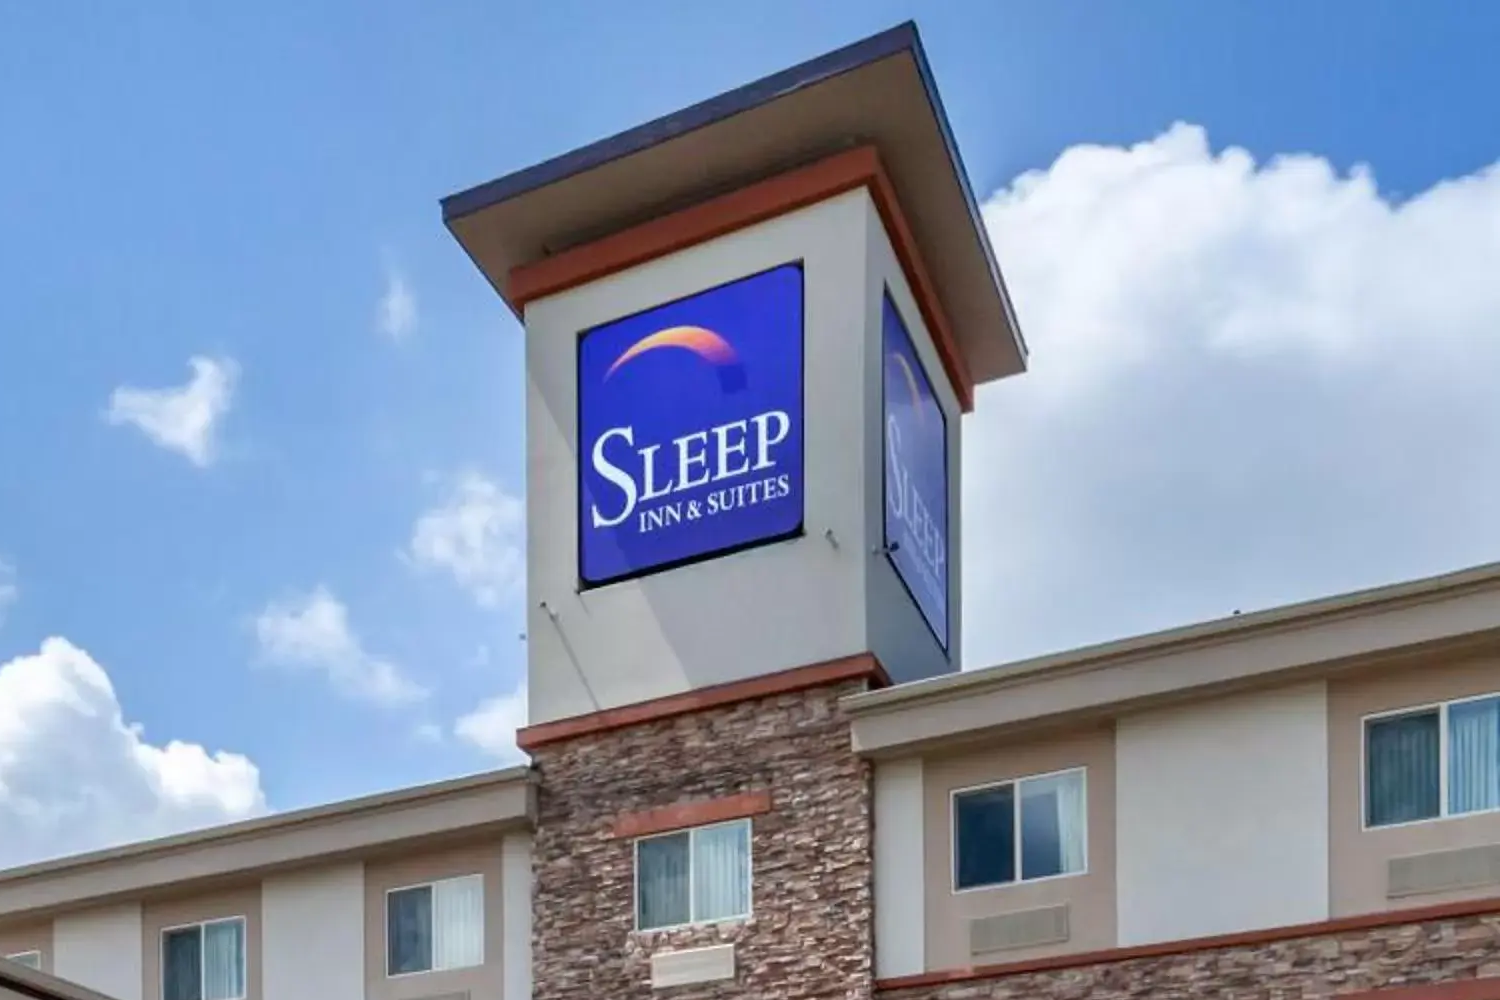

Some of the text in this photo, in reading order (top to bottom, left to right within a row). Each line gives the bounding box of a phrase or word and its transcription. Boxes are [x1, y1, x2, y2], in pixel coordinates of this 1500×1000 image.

[591, 410, 790, 529] SLEEP
[638, 473, 790, 533] INN & SUITES
[887, 413, 944, 579] SLEEP
